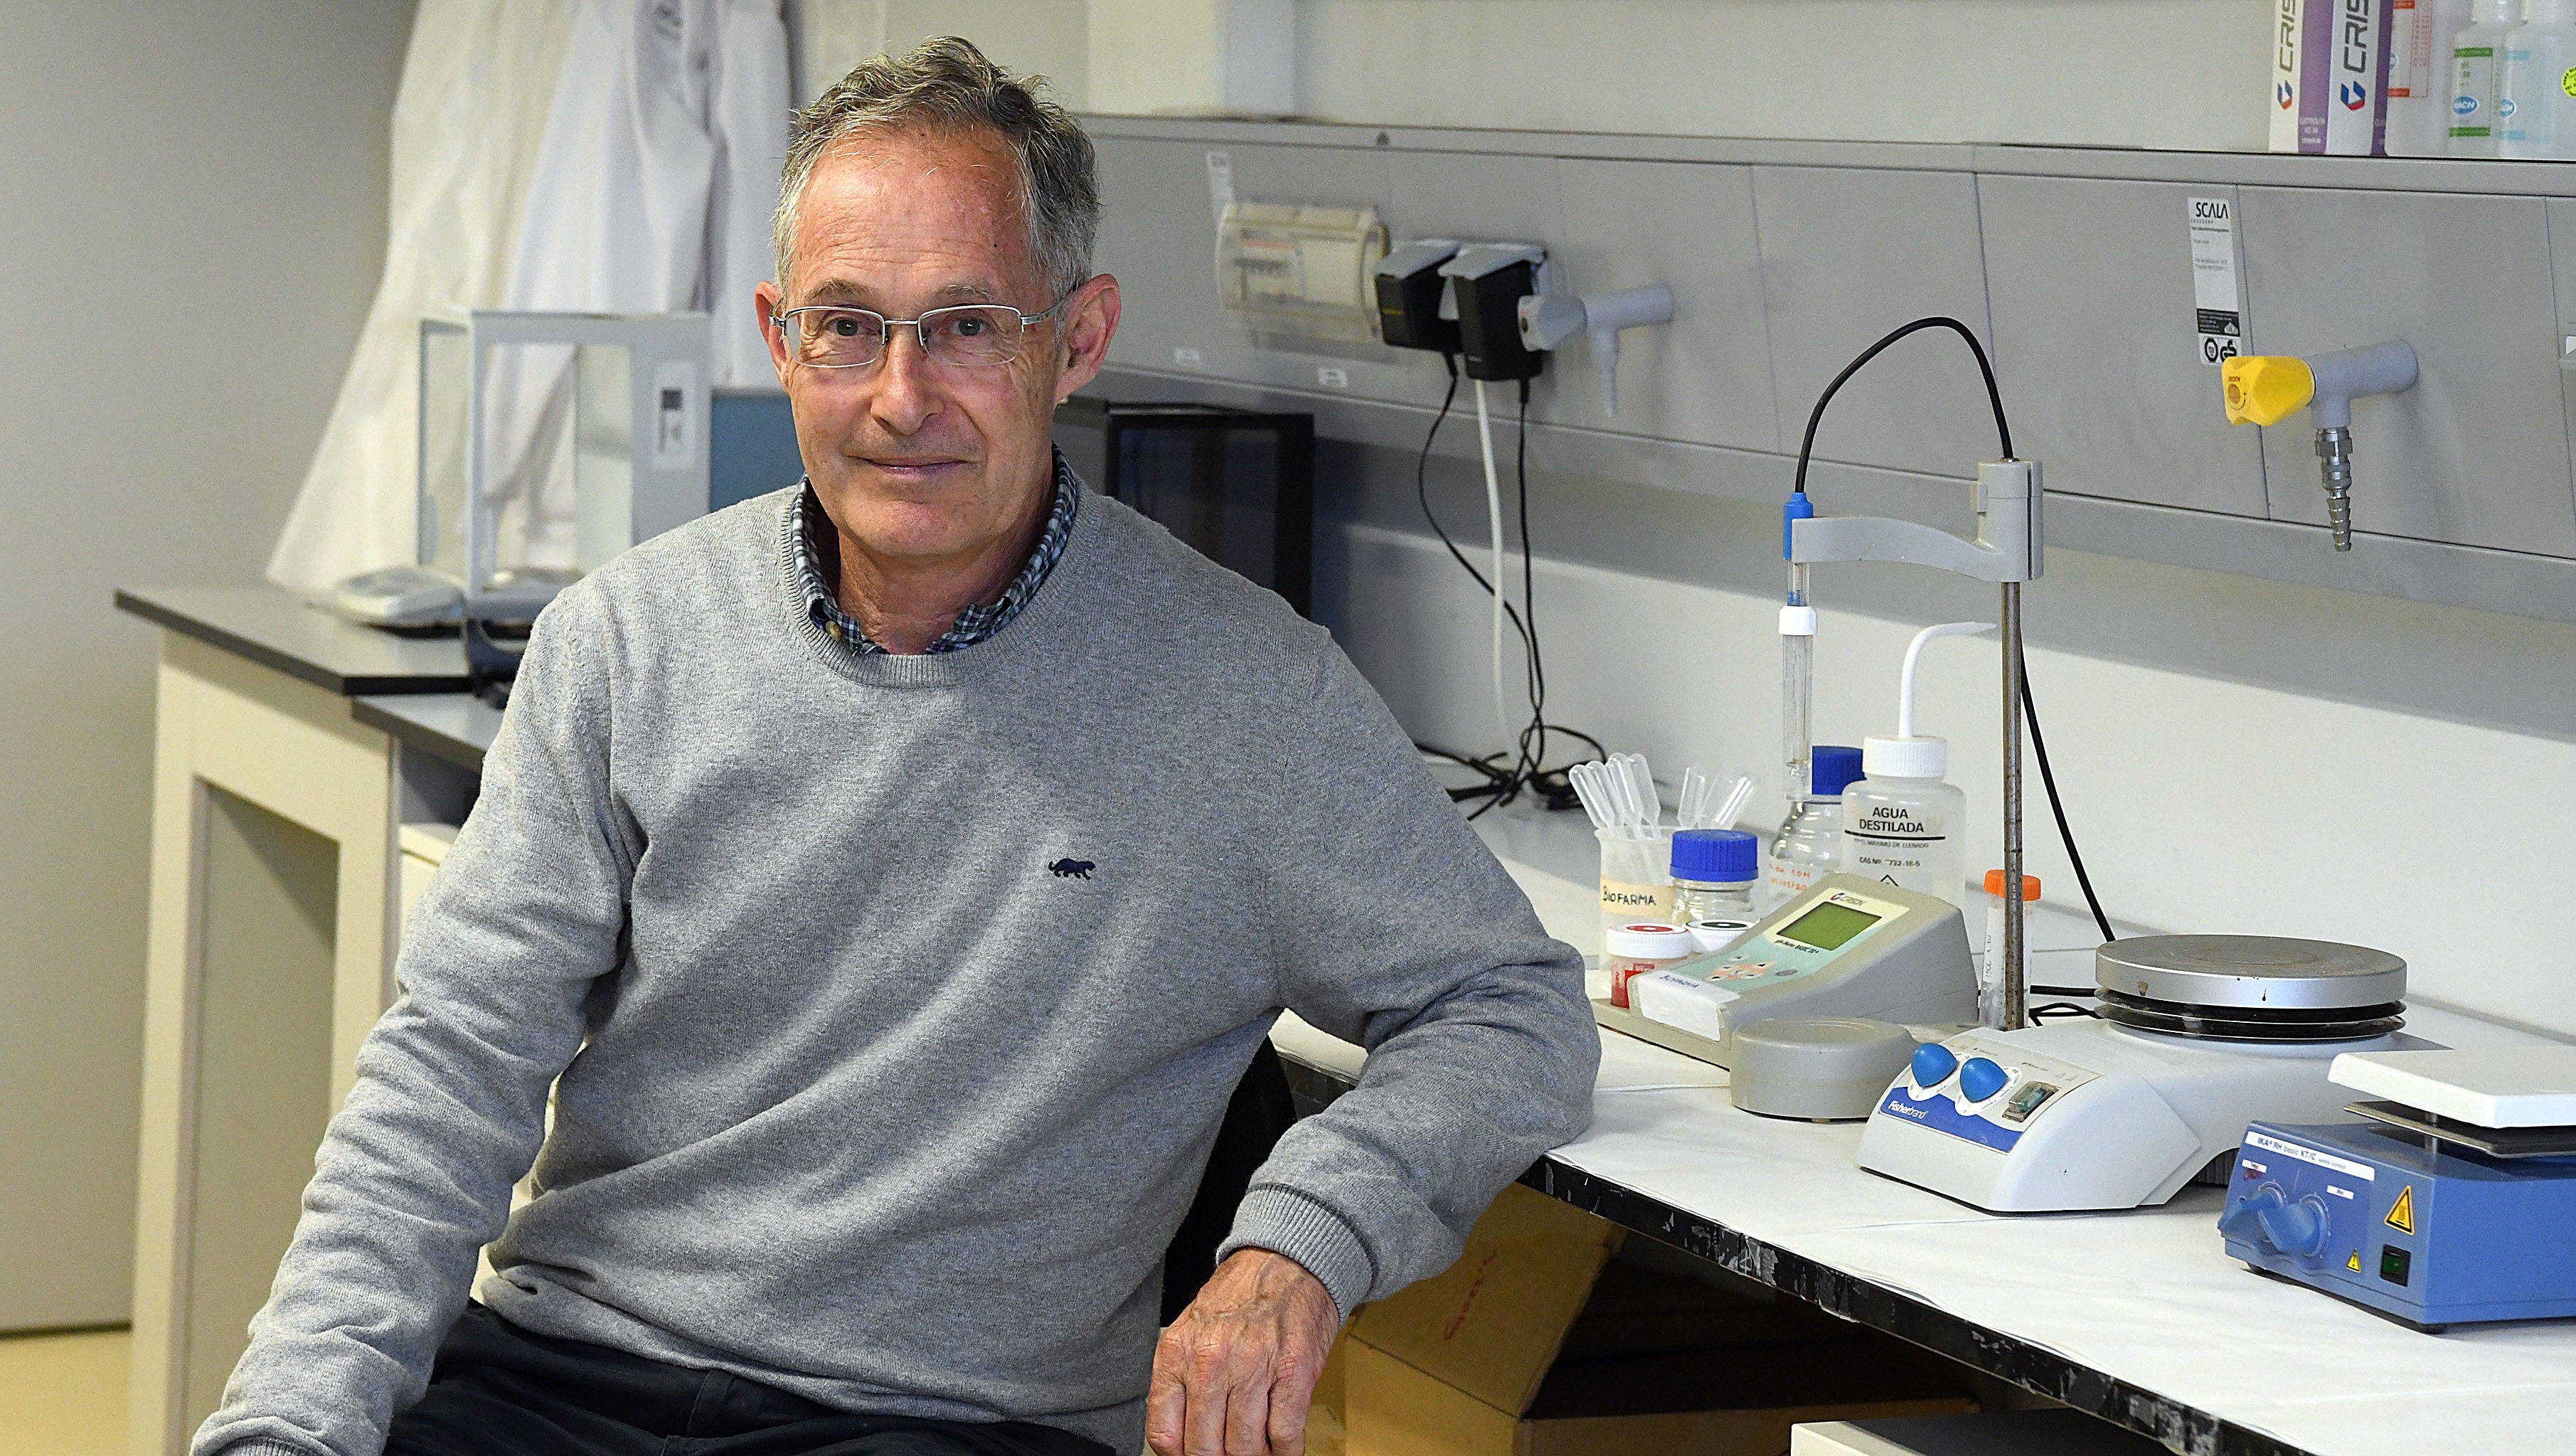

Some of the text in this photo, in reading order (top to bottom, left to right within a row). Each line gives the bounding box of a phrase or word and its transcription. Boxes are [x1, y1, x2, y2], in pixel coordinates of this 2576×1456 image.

[2196, 201, 2229, 219] SCALA
[1872, 807, 1909, 819] AGUA
[1858, 819, 1925, 832] DESTILADA
[1888, 1100, 1929, 1119] Fisherbrand
